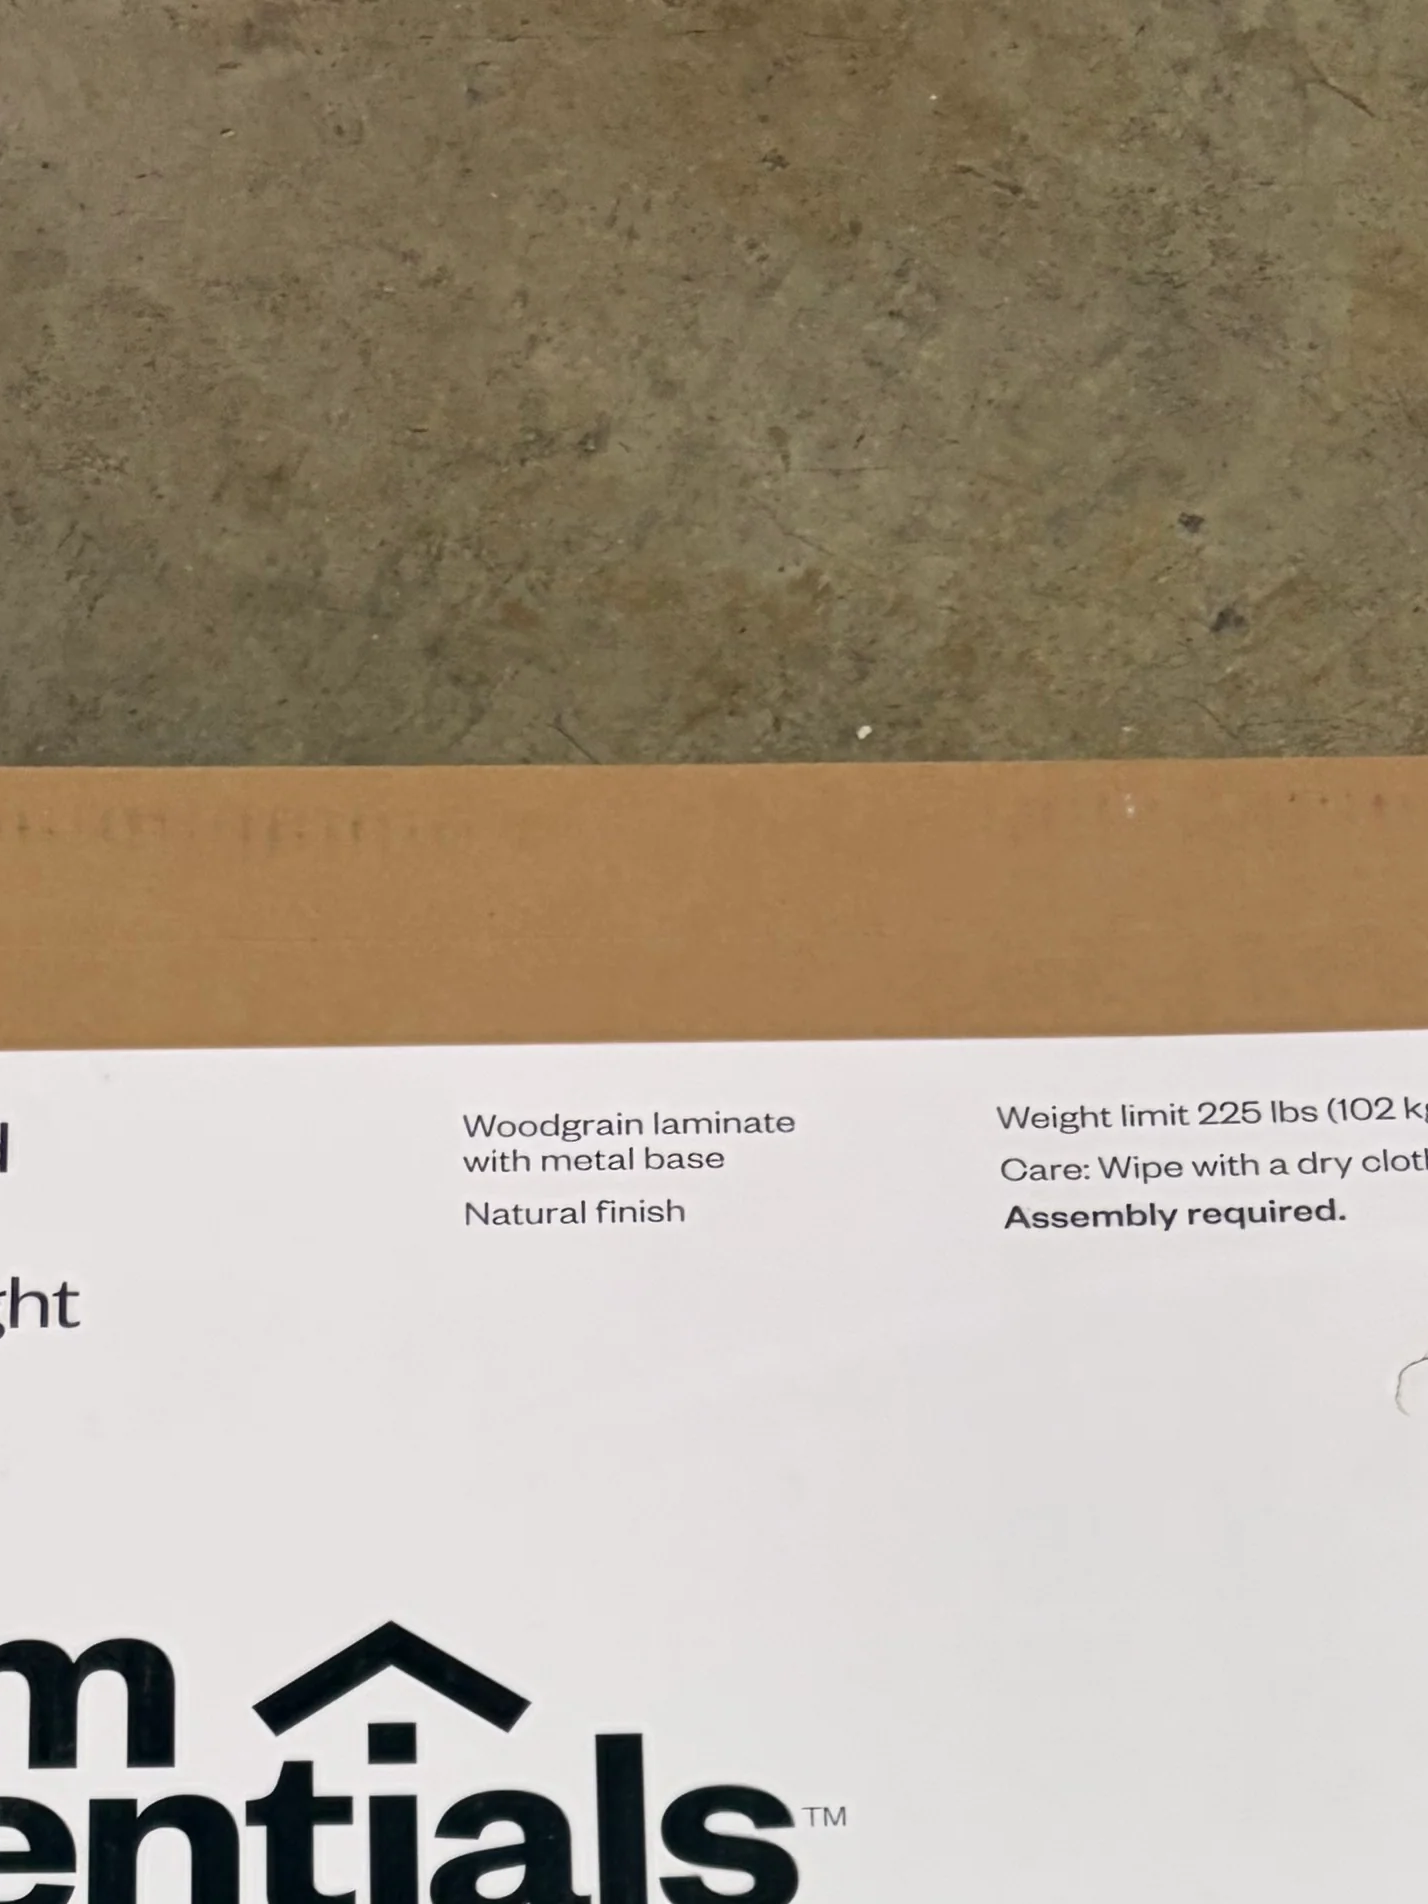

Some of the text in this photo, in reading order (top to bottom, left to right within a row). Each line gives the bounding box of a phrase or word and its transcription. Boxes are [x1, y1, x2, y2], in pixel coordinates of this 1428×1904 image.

[463, 1111, 795, 1142] Woodgrain laminate
[997, 1105, 1112, 1134] Weight
[1122, 1103, 1189, 1126] limit
[1198, 1101, 1261, 1125] 225
[1271, 1101, 1318, 1123] lbs
[1328, 1097, 1396, 1123] (102
[463, 1147, 724, 1172] with metal base
[1001, 1158, 1090, 1181] Care:
[1098, 1156, 1183, 1184] Wipe
[1192, 1153, 1259, 1177] with
[1270, 1159, 1289, 1175] a
[1298, 1152, 1352, 1179] dry
[466, 1199, 684, 1225] Natural finish
[1005, 1198, 1346, 1231] Assembly required.
